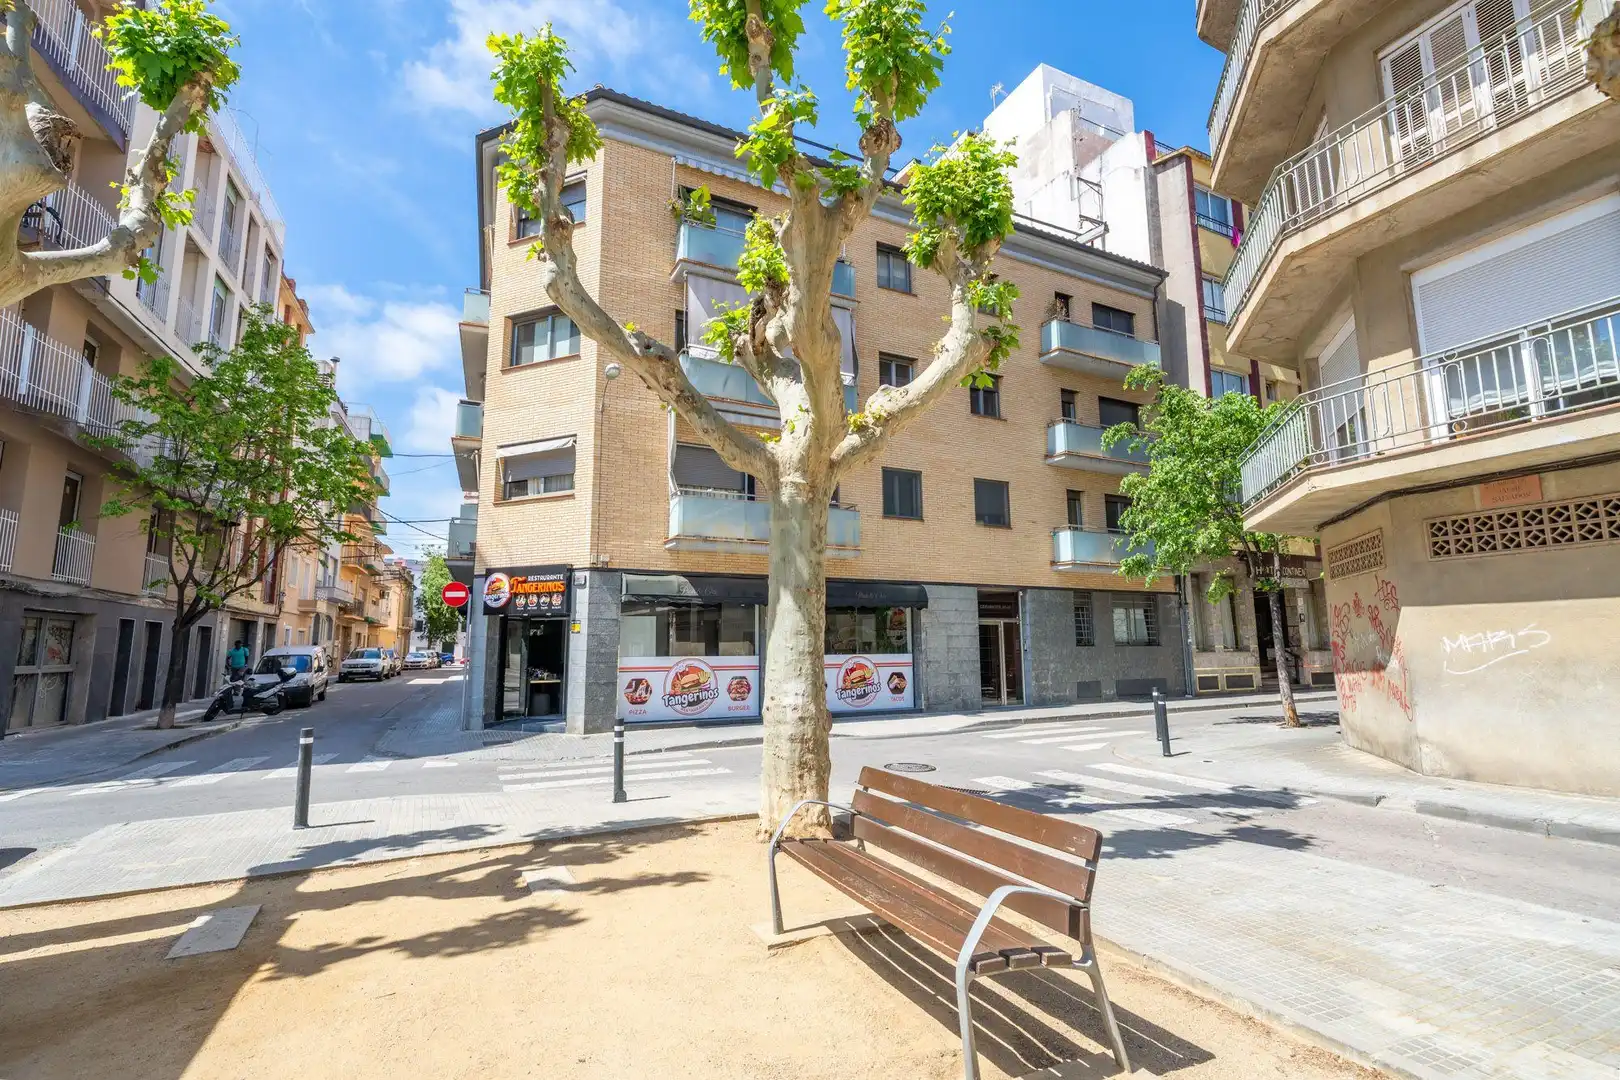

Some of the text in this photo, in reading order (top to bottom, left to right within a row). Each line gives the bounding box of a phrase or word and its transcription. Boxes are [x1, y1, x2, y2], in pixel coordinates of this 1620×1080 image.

[510, 577, 566, 594] TANGERINOS
[528, 573, 564, 582] RESTAURANTE
[662, 688, 719, 707] Tangerinos
[835, 682, 882, 701] Tangerinos
